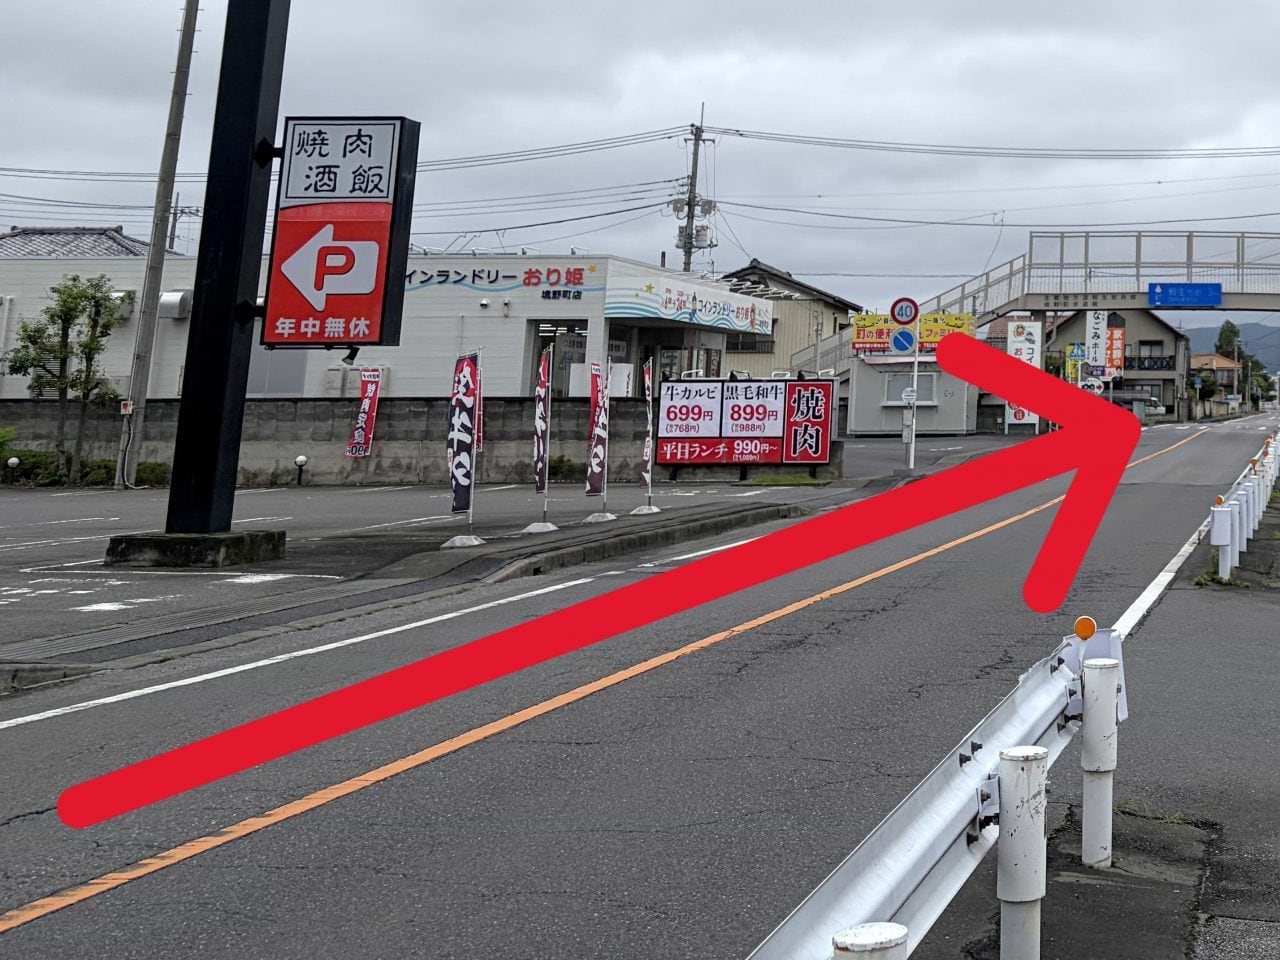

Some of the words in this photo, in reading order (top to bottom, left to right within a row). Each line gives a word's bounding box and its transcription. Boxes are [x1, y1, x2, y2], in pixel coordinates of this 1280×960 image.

[295, 128, 373, 158] 焼肉
[303, 164, 384, 194] 酒飯
[313, 245, 356, 292] P
[522, 267, 585, 287] おり姫
[541, 290, 582, 300] 境野町店
[896, 305, 913, 319] 40
[274, 317, 370, 338] 年中無休
[664, 385, 718, 401] 牛カルビ
[725, 385, 784, 400] 黒毛和牛
[666, 404, 713, 422] 699円
[730, 404, 778, 422] 899円
[790, 386, 826, 457] 焼肉
[660, 441, 728, 460] 平日ランチ
